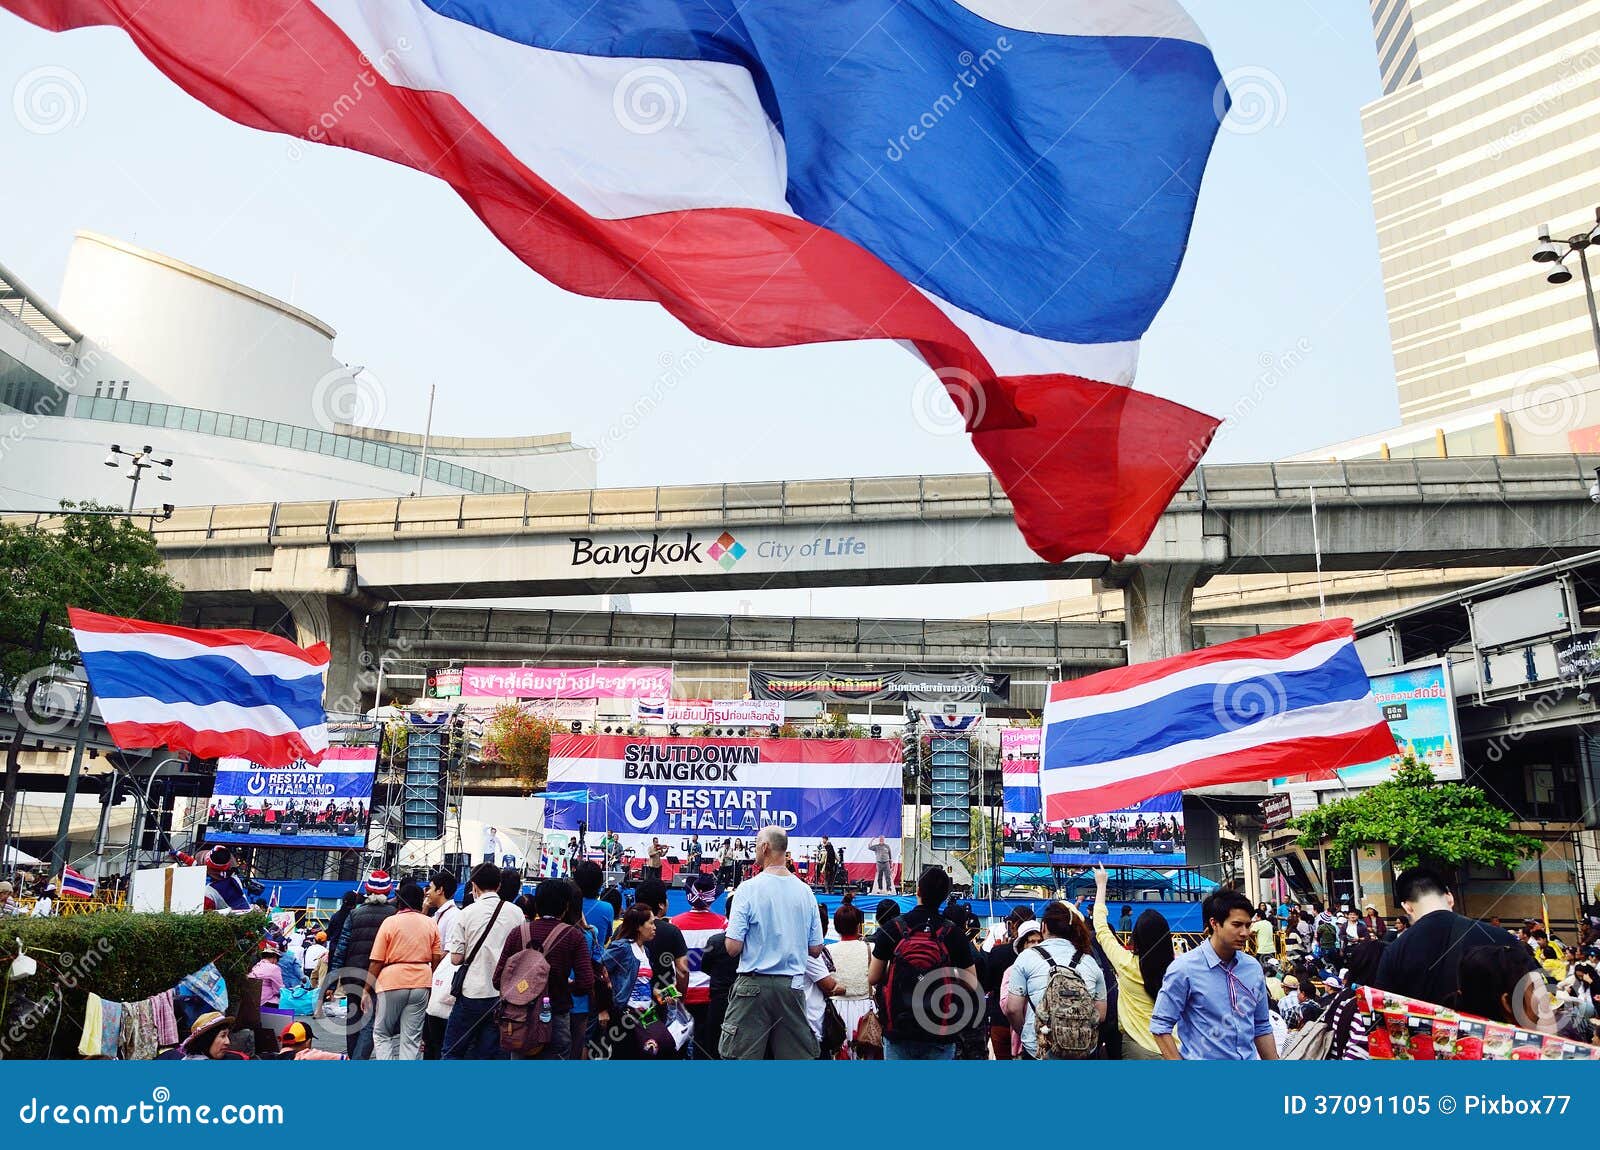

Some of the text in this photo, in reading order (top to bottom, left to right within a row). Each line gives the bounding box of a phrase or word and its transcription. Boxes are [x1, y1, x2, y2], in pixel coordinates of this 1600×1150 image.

[569, 532, 866, 575] Bangkok City of Life
[624, 744, 760, 764] SHUTDOWN
[269, 774, 323, 784] RESTART
[623, 762, 738, 782] BANGKOK
[268, 784, 335, 795] THAILAND
[666, 789, 772, 809] RESTART
[665, 809, 798, 832] THAILAND
